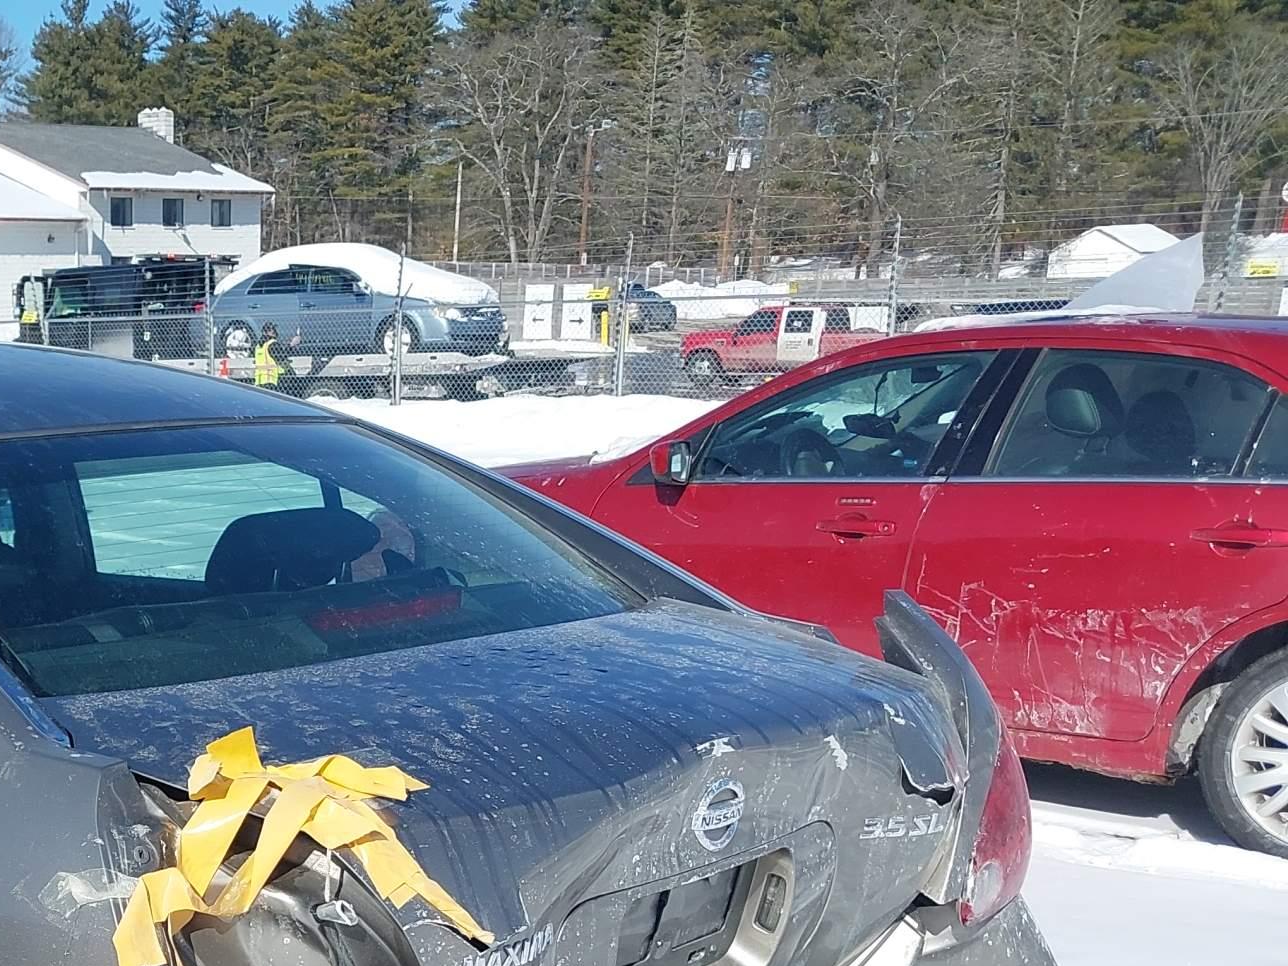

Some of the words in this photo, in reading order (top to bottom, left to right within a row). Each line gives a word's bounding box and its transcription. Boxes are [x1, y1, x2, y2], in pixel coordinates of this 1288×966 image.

[701, 808, 741, 827] NISSAN
[859, 816, 906, 839] 3.5
[908, 813, 944, 837] SL
